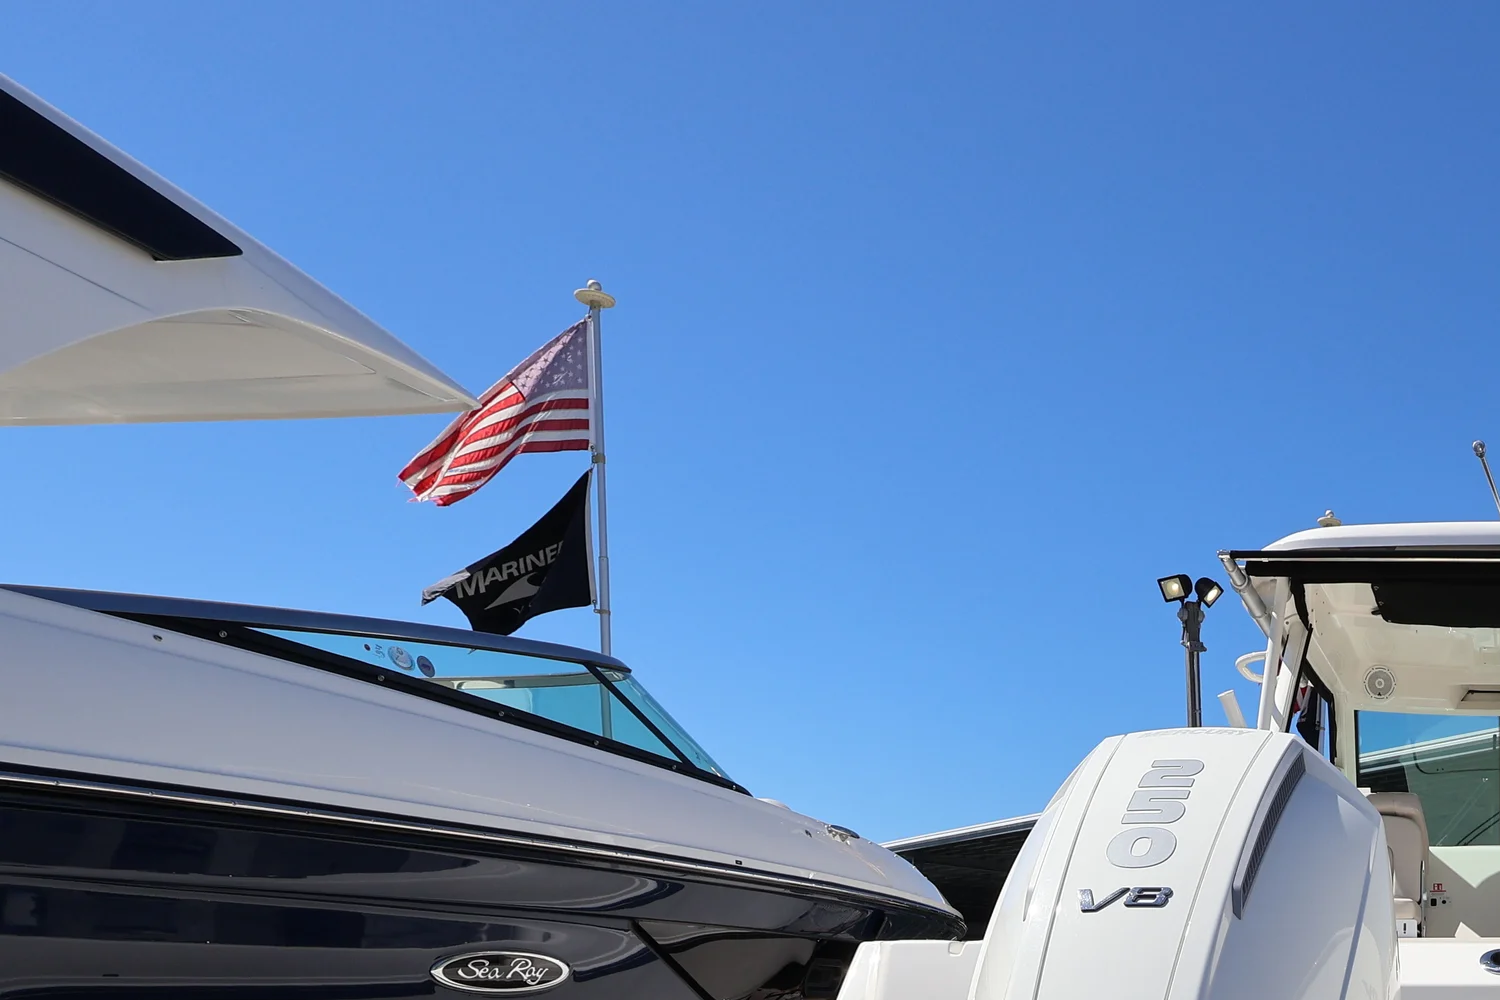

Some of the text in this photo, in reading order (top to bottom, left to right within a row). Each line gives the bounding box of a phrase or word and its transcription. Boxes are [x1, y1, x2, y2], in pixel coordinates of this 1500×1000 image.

[1106, 759, 1205, 869] 250
[1077, 886, 1174, 913] V8
[457, 957, 549, 985] Sea Ray
